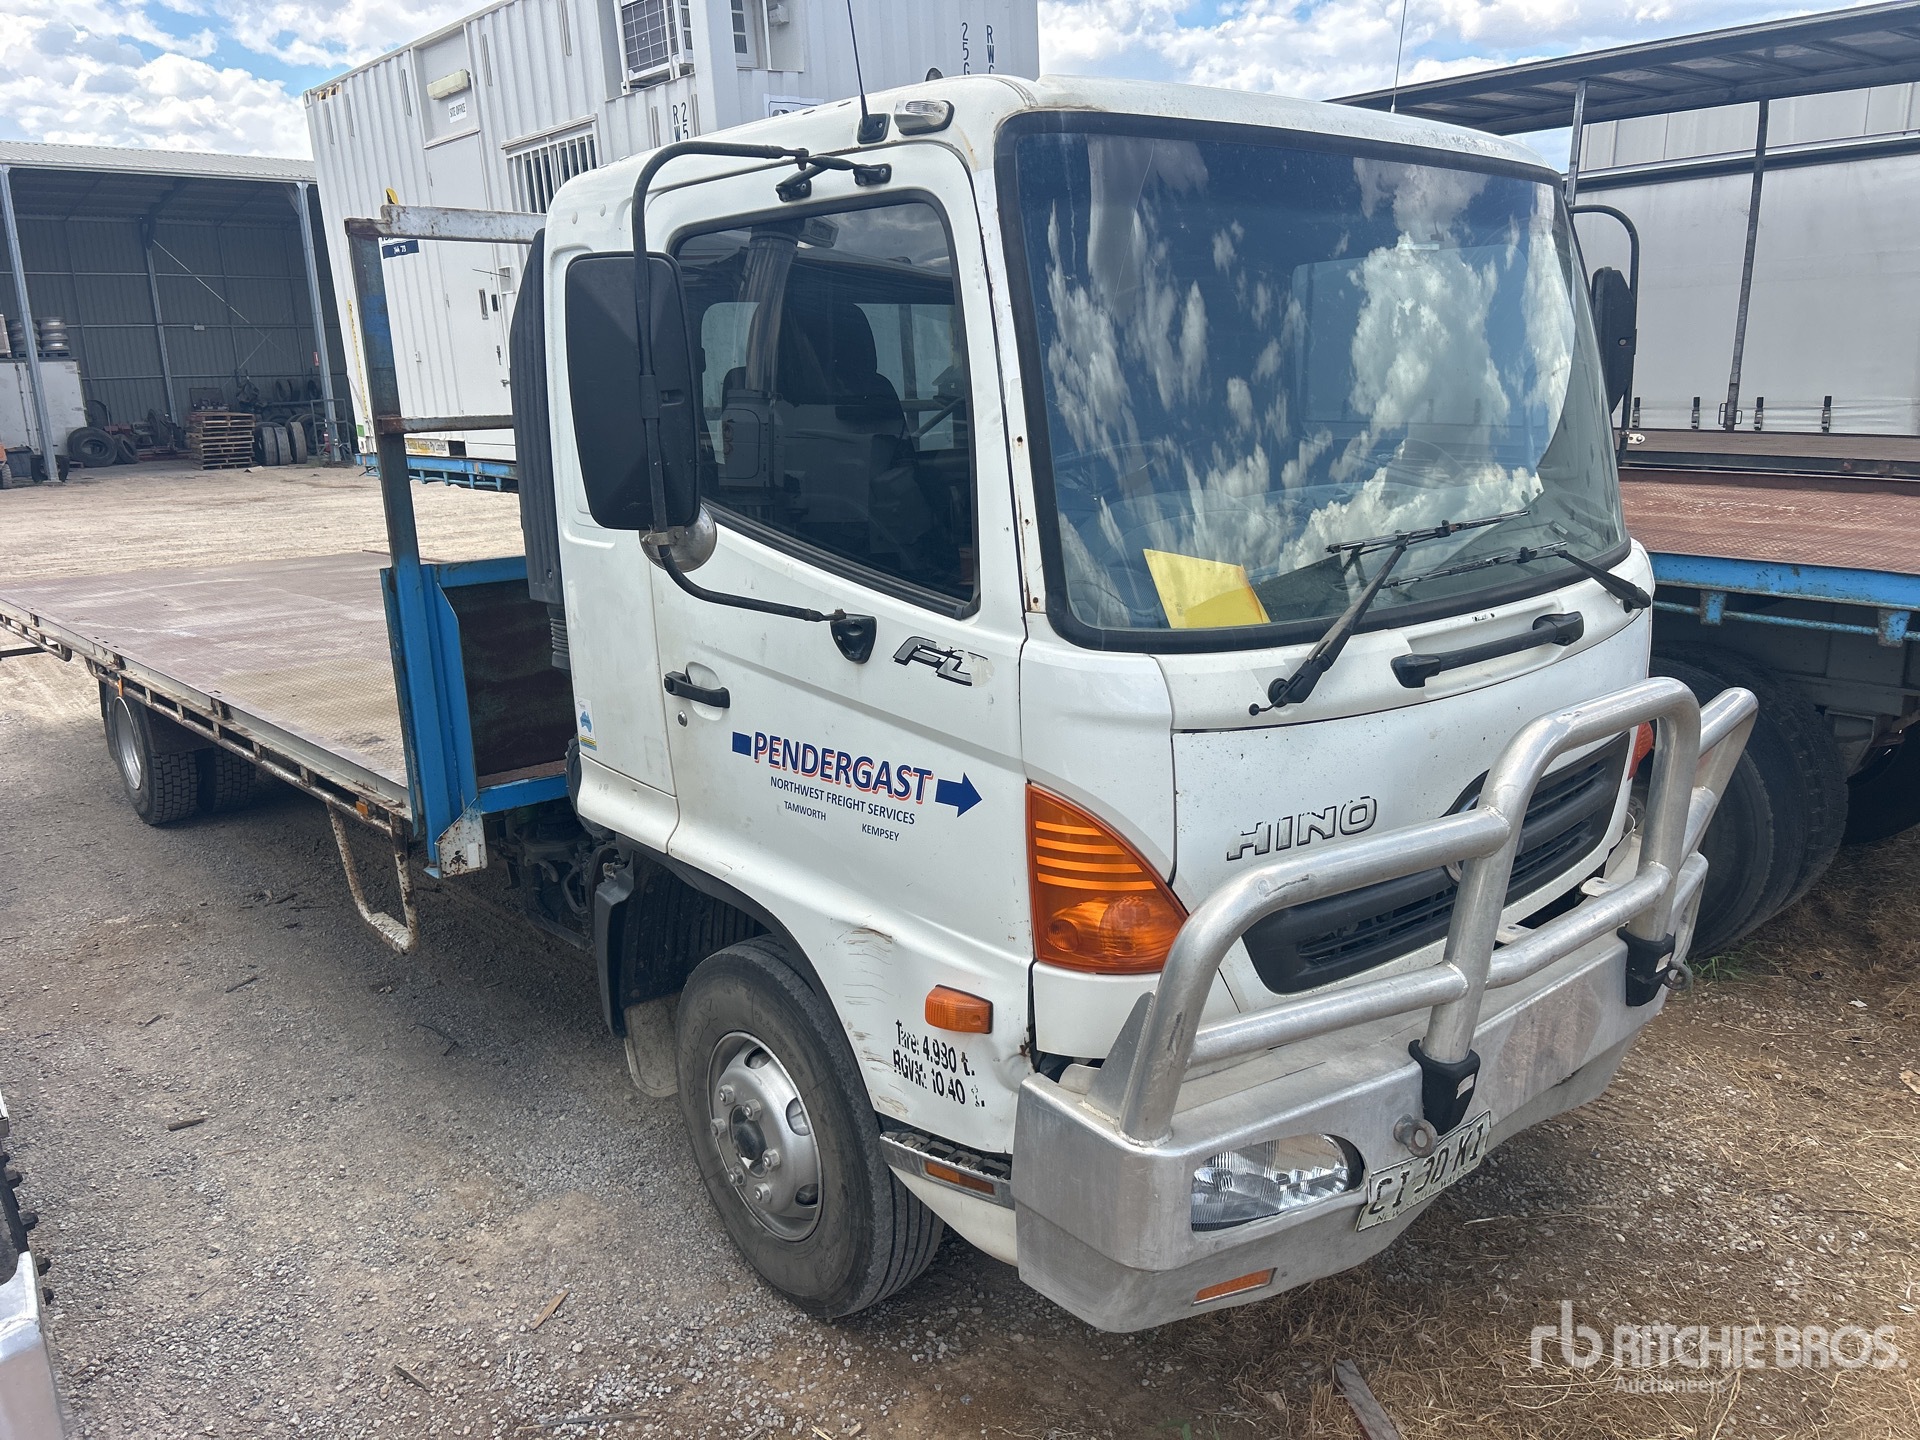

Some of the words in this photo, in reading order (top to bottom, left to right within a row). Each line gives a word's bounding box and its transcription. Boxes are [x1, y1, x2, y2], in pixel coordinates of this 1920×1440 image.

[753, 731, 934, 806] PENDERGAST
[770, 776, 824, 802] NORTHWEST
[826, 791, 866, 814] FREIGHT
[867, 802, 915, 826] SERVICES
[783, 800, 827, 822] TAMWORTH
[861, 823, 900, 842] KEMPSEY
[1226, 795, 1378, 862] HINO
